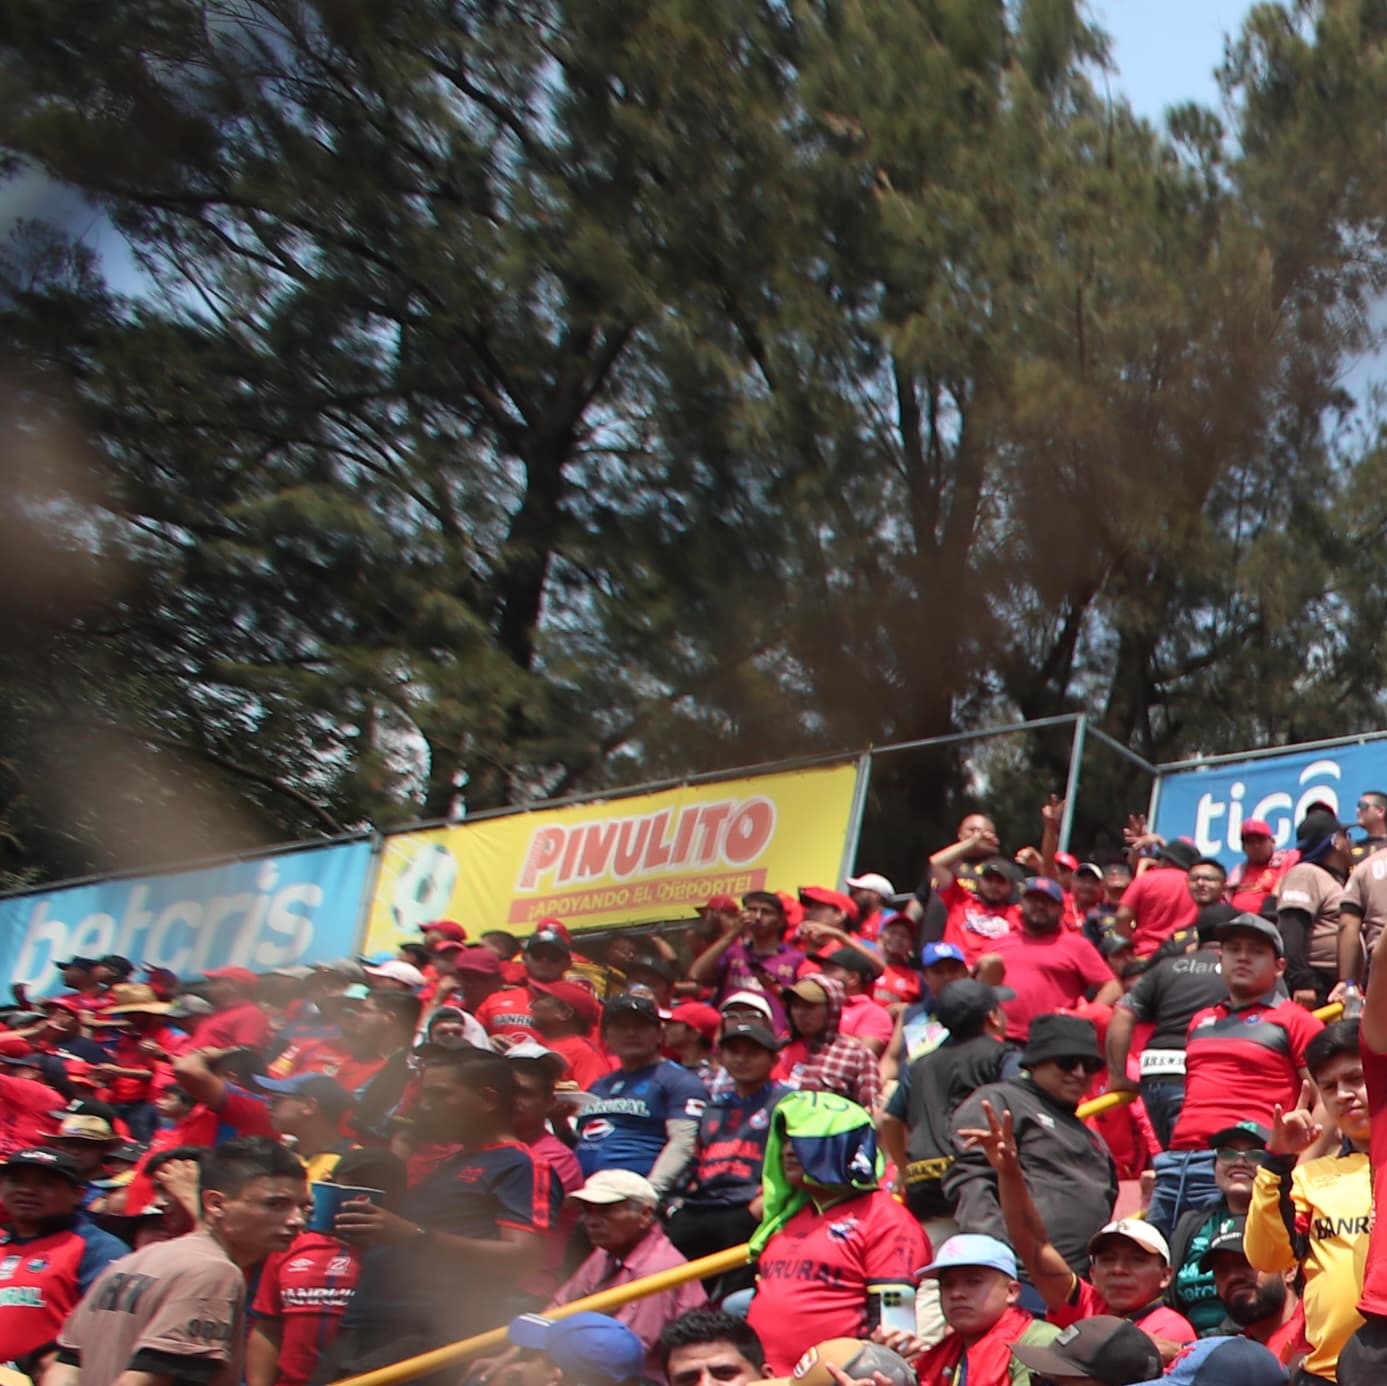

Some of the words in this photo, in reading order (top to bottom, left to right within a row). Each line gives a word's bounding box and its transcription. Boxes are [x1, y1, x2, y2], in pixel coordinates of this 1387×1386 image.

[516, 794, 777, 892] PINULITO
[11, 860, 324, 1000] betcris
[634, 884, 652, 903] EL
